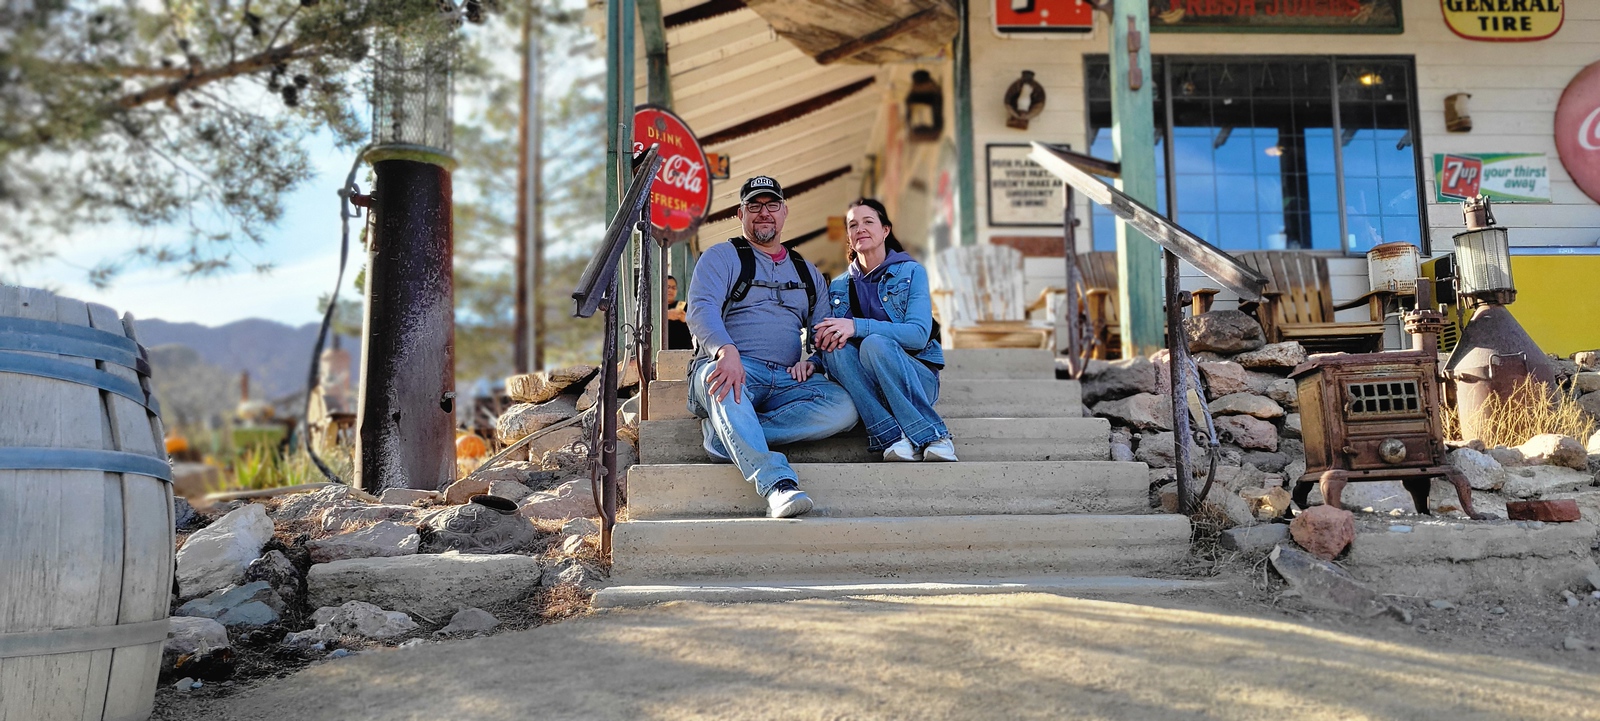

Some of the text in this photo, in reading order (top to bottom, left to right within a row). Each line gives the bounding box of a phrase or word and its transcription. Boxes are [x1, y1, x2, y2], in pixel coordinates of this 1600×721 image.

[1264, 0, 1361, 17] JUICES
[1446, 0, 1560, 12] GENERAL
[1477, 16, 1532, 31] TIRE
[1484, 165, 1547, 180] your thirst
[751, 178, 773, 187] FORD
[1504, 178, 1537, 191] away
